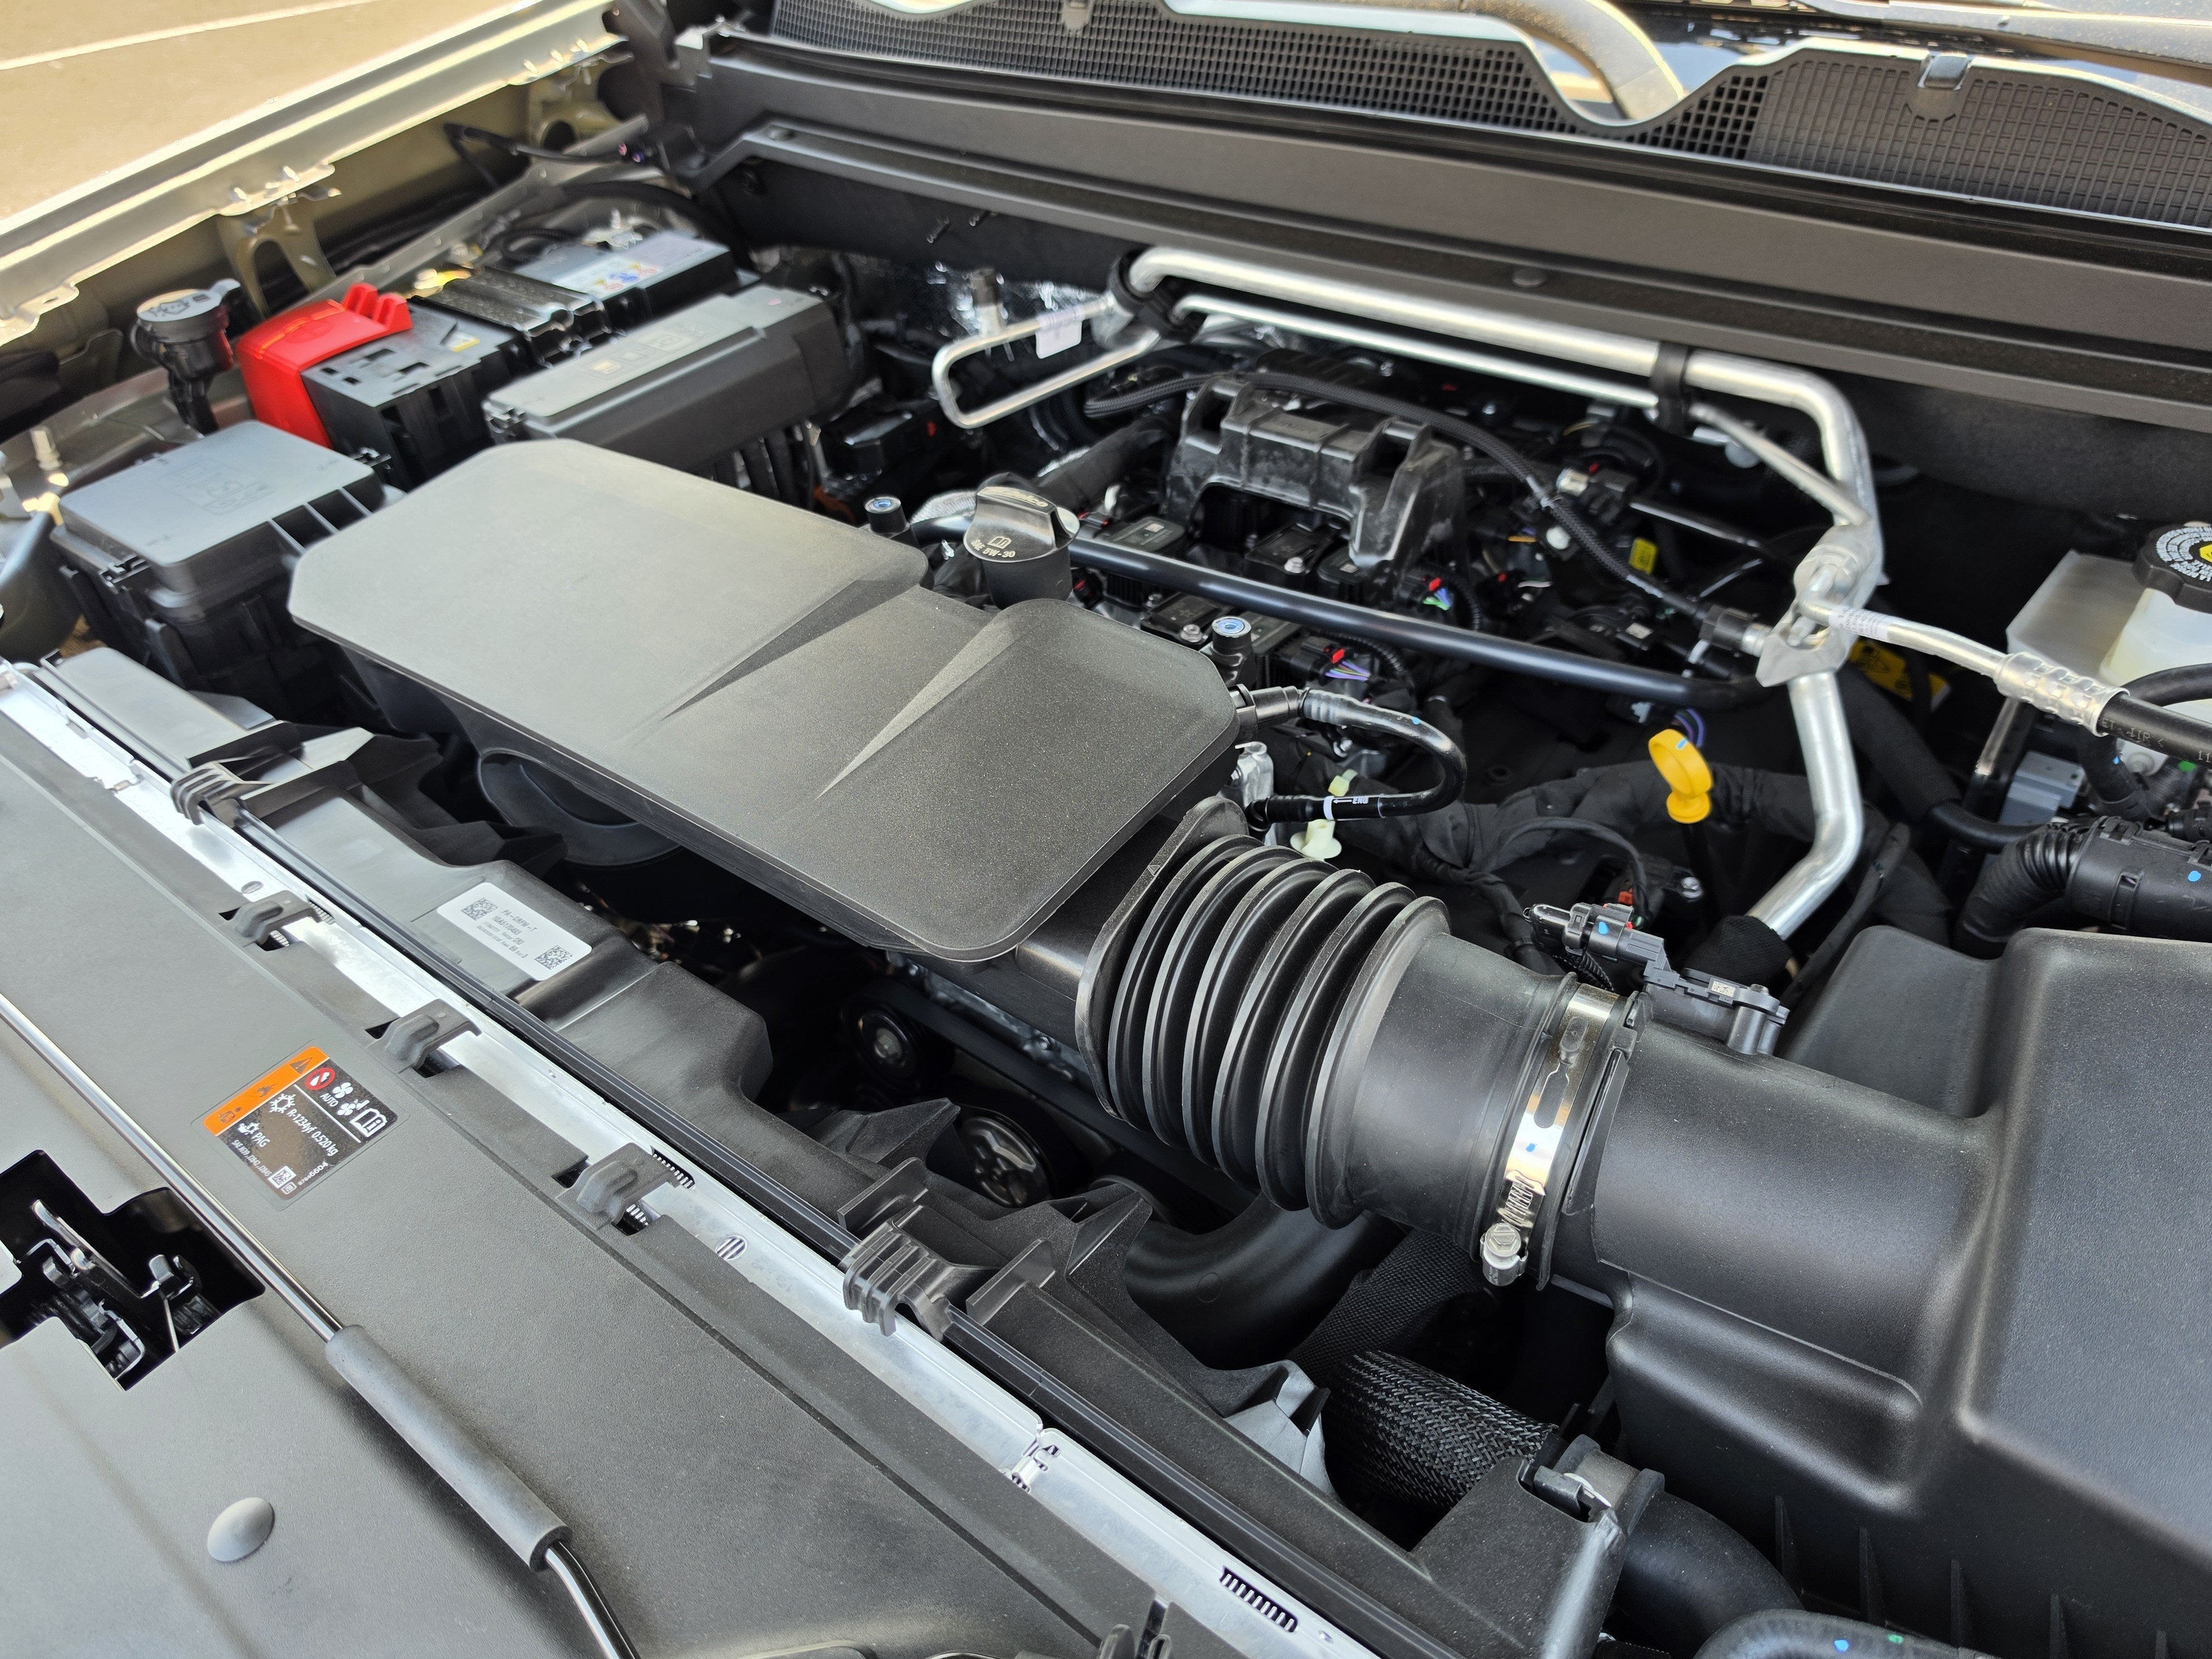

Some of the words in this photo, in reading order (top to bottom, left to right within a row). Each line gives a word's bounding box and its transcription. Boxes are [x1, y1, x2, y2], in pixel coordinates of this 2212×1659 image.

[992, 488, 1048, 507] CDelco
[971, 540, 985, 551] SAE
[983, 548, 1016, 559] 5W-30
[320, 1092, 338, 1107] AUTO
[252, 1132, 270, 1147] PAG
[286, 1108, 316, 1135] R-1234yf
[311, 1130, 333, 1148] 0.520
[325, 1144, 340, 1156] kg
